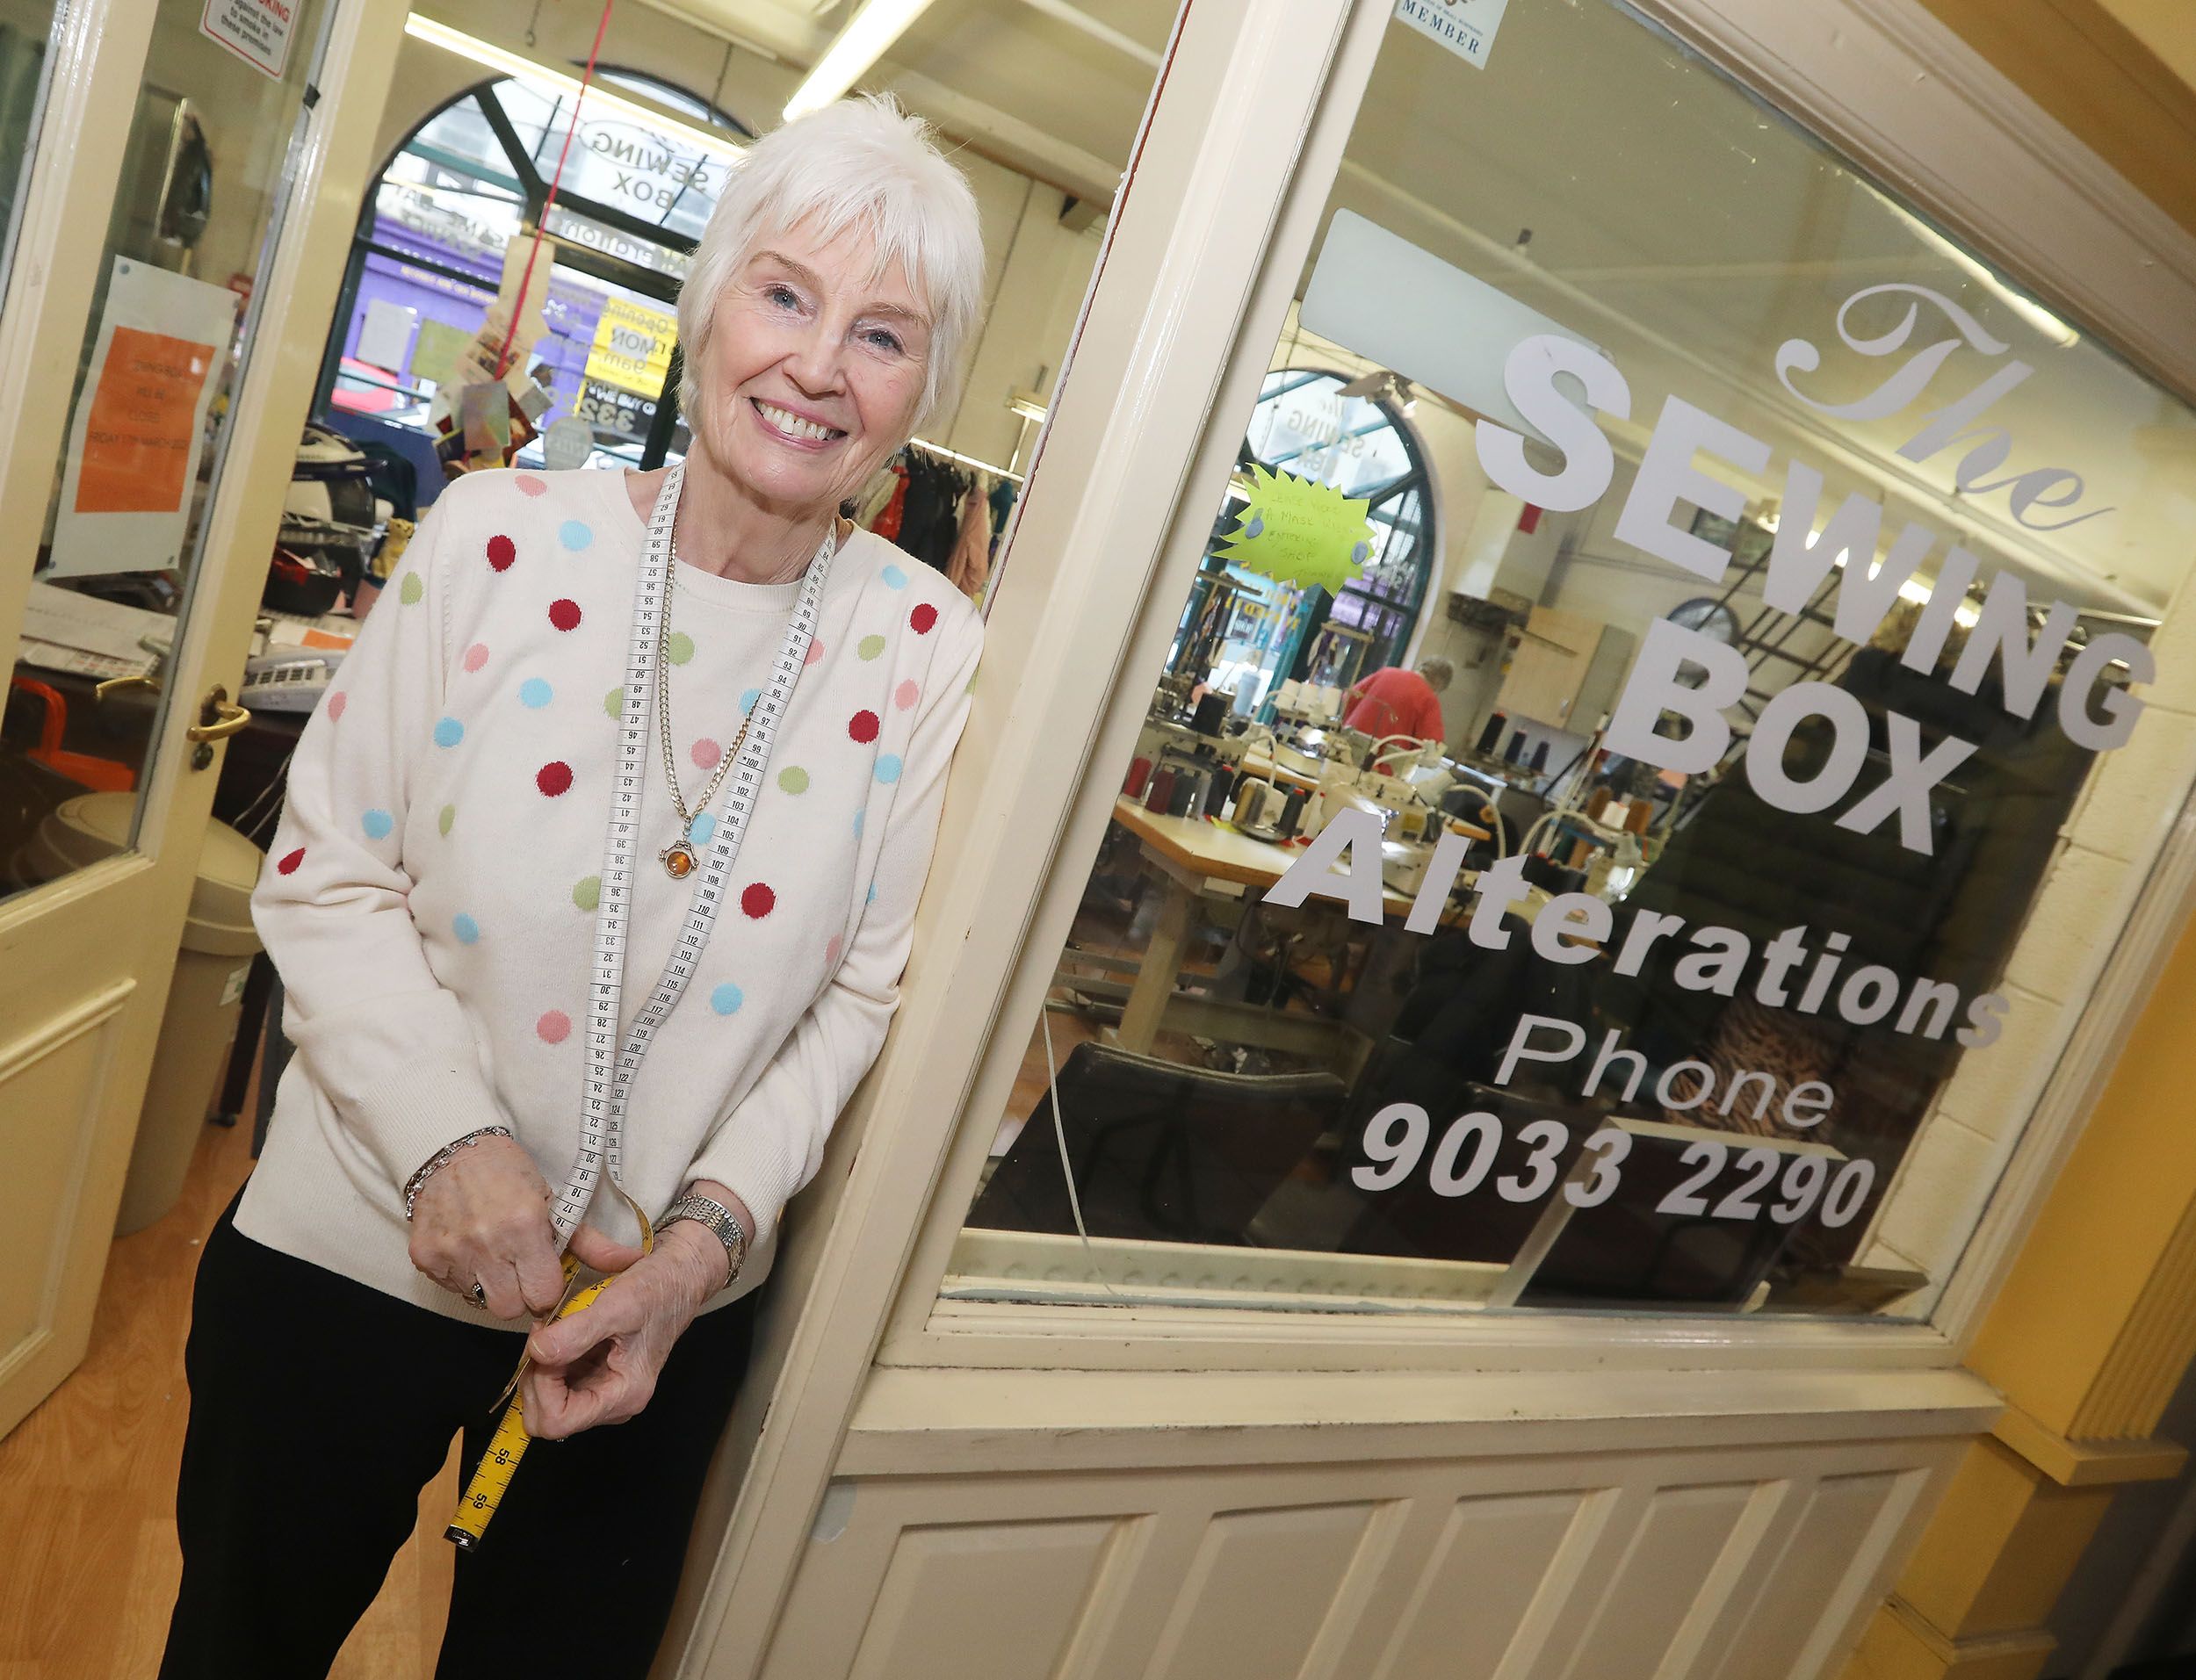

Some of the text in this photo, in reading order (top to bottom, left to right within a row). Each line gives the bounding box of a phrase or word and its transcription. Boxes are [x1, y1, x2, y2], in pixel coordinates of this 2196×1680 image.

[1403, 0, 1478, 54] MEMBER
[1775, 283, 2117, 530] The
[1475, 333, 2156, 753] SEWING
[803, 609, 811, 618] 89
[798, 622, 806, 631] 90
[793, 635, 801, 644] 91
[788, 647, 798, 657] 92
[783, 661, 792, 670] 93
[777, 674, 787, 684] 94
[772, 689, 781, 698] 95
[767, 703, 776, 712] 96
[761, 717, 770, 726] 97
[756, 731, 765, 739] 98
[1602, 616, 1978, 856] BOX
[626, 746, 636, 755] 45
[752, 744, 762, 753] 99
[747, 757, 759, 768] 100
[741, 771, 753, 782] 101
[737, 786, 749, 796] 102
[732, 800, 744, 811] 103
[726, 815, 739, 826] 104
[722, 830, 734, 840] 105
[717, 844, 730, 855] 106
[712, 859, 725, 870] 107
[613, 872, 623, 881] 37
[706, 874, 719, 885] 108
[610, 888, 621, 897] 36
[703, 889, 715, 900] 109
[609, 905, 619, 913] 35
[697, 905, 710, 915] 110
[607, 920, 618, 929] 34
[692, 919, 704, 930] 111
[1261, 807, 2010, 1049] Alterations
[605, 937, 616, 946] 33
[686, 934, 699, 945] 112
[603, 953, 614, 963] 32
[680, 949, 692, 961] 113
[602, 970, 612, 978] 31
[674, 965, 685, 976] 114
[666, 979, 679, 989] 115
[600, 985, 611, 995] 30
[659, 992, 671, 1003] 116
[598, 1002, 609, 1011] 29
[651, 1006, 663, 1014] 117
[597, 1019, 607, 1027] 28
[635, 1028, 647, 1038] 119
[596, 1035, 605, 1044] 27
[629, 1042, 641, 1052] 120
[595, 1050, 604, 1060] 26
[624, 1058, 634, 1067] 121
[595, 1067, 604, 1077] 25
[1494, 1013, 1834, 1128] Phone
[618, 1073, 629, 1082] 122
[593, 1083, 603, 1093] 24
[614, 1089, 625, 1098] 123
[591, 1100, 601, 1110] 23
[611, 1105, 620, 1114] 124
[589, 1118, 599, 1128] 22
[609, 1121, 618, 1131] 125
[588, 1136, 596, 1146] 21
[585, 1153, 596, 1163] 20
[1352, 1102, 1875, 1228] 9033 2290
[579, 1171, 589, 1181] 19
[571, 1187, 582, 1198] 18
[562, 1204, 574, 1214] 17
[555, 1217, 566, 1227] 16
[495, 1447, 510, 1466] 58
[473, 1493, 487, 1510] 59
